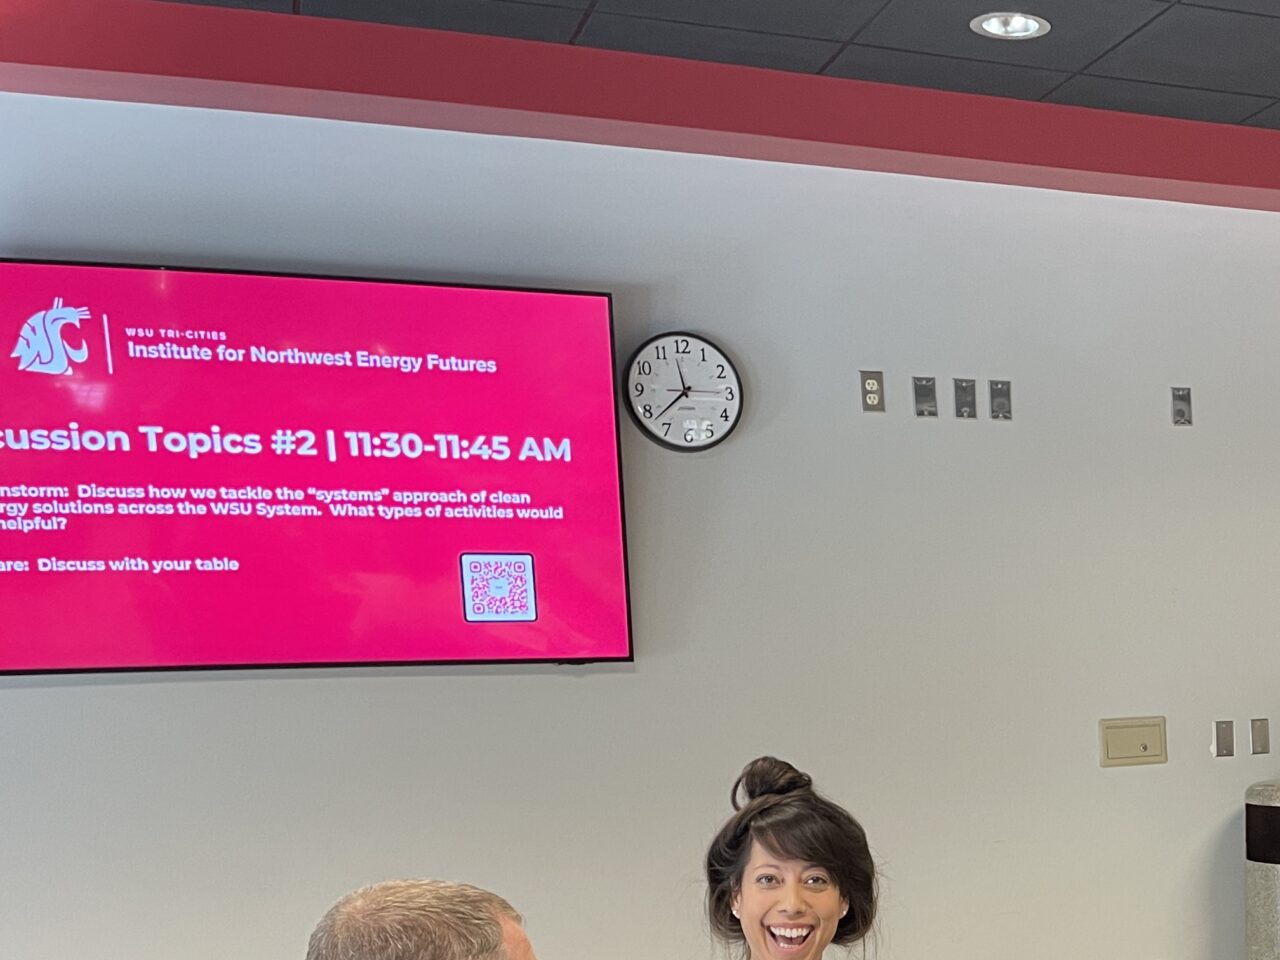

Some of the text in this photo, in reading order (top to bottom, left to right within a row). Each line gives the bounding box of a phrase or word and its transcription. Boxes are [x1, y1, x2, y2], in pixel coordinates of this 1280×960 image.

[125, 327, 226, 340] WSU TRI-CITIES
[655, 345, 667, 360] 11
[674, 339, 692, 354] 12
[128, 341, 496, 372] Institute for Northwest Energy Futures
[700, 347, 707, 362] 1
[637, 360, 652, 375] 10
[716, 364, 727, 379] 2
[634, 382, 645, 397] 9
[725, 386, 735, 401] 3
[642, 403, 653, 419] 8
[719, 407, 730, 422] 4
[661, 422, 672, 437] 7
[683, 428, 694, 443] 6
[705, 423, 715, 439] 5
[0, 422, 130, 451] ussion
[138, 425, 262, 458] Topics
[271, 430, 317, 455] #2
[344, 432, 510, 460] 11:30-11:45
[519, 437, 571, 462] AM
[78, 484, 145, 498] Discuss
[148, 485, 186, 498] how
[190, 489, 216, 499] we
[219, 486, 272, 499] tackle
[275, 487, 304, 500] the
[393, 490, 467, 504] approach
[470, 490, 486, 503] of
[489, 491, 530, 504] clean
[32, 500, 114, 514] solutions
[118, 504, 174, 514] across
[177, 501, 207, 514] the
[210, 502, 252, 515] WSU
[256, 503, 322, 518] System.
[329, 504, 374, 516] What
[377, 503, 422, 519] types
[425, 505, 441, 517] of
[445, 505, 514, 518] activities
[516, 507, 563, 519] would
[38, 557, 105, 571] Discuss
[109, 557, 149, 570] with
[152, 560, 191, 573] your
[195, 558, 239, 570] table
